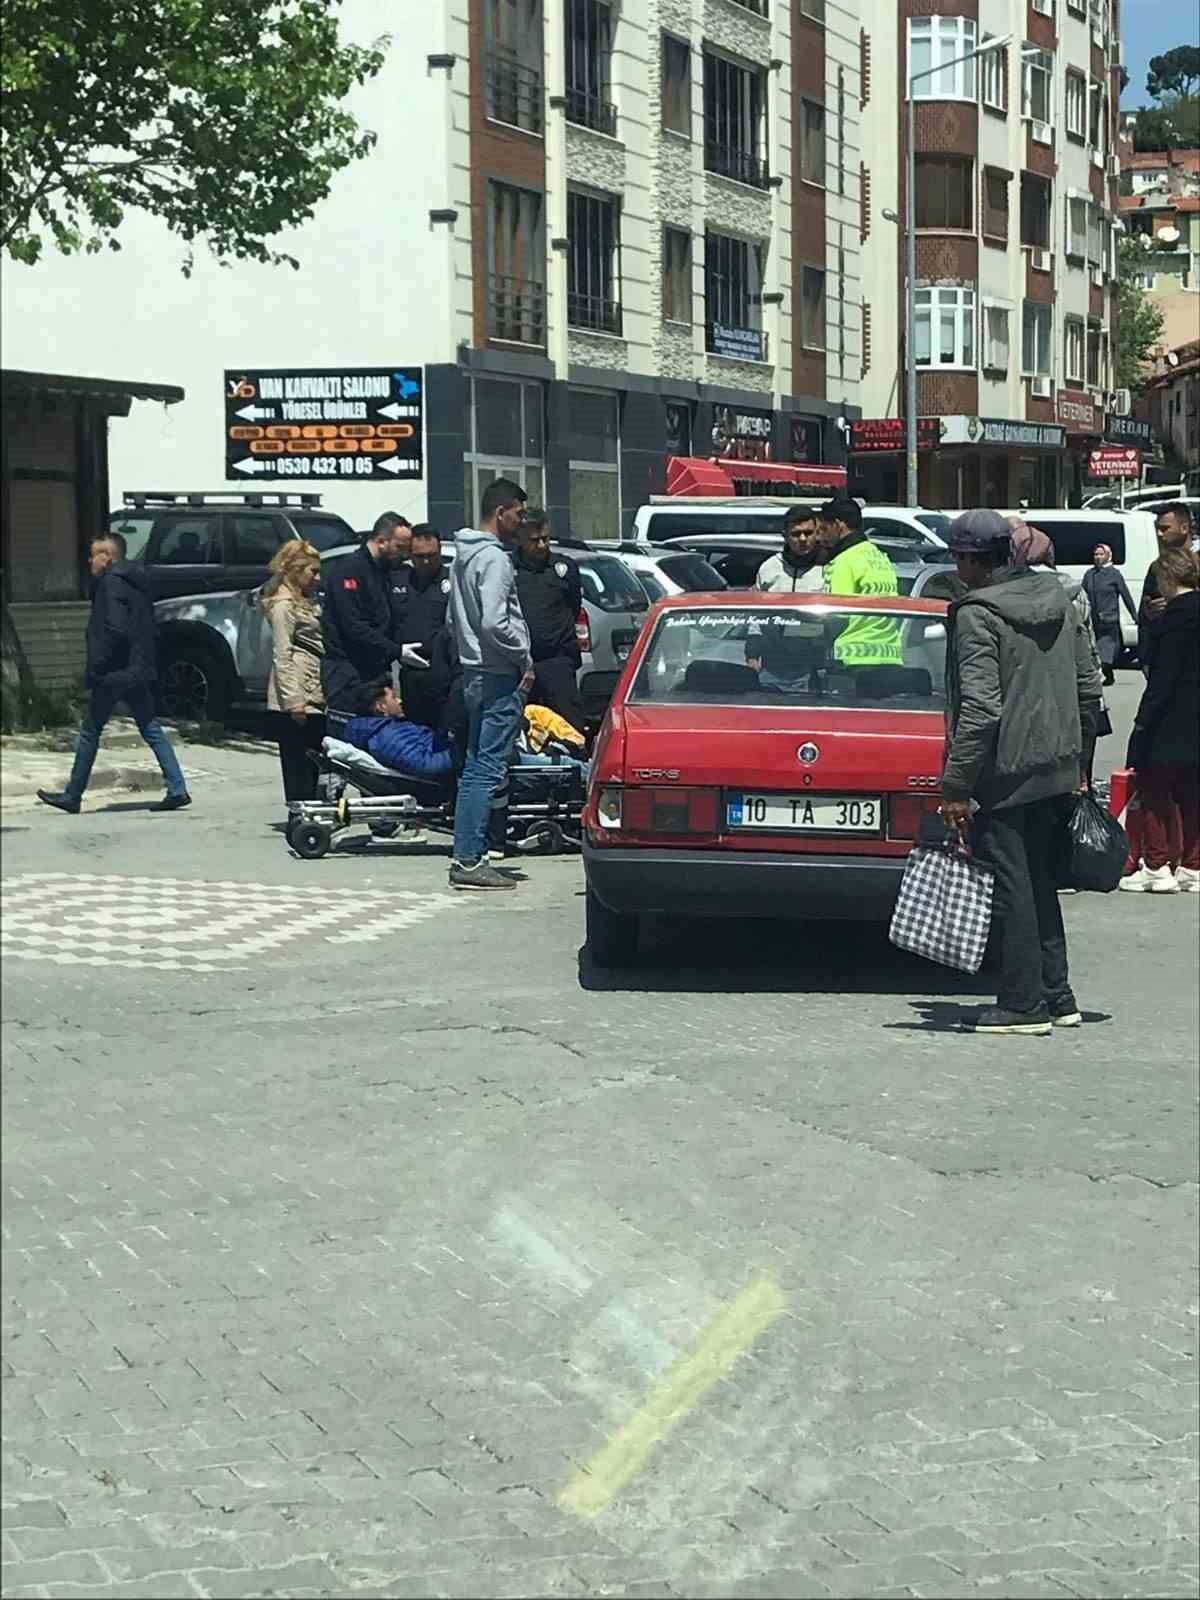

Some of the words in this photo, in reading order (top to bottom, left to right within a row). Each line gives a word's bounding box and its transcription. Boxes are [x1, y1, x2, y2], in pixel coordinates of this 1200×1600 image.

[258, 376, 283, 399] VAN
[284, 376, 341, 399] KAHVALTI
[343, 375, 391, 398] SALONU
[276, 457, 310, 475] 0530
[312, 457, 337, 475] 432
[338, 457, 355, 474] 10
[745, 797, 767, 822] 10
[789, 799, 814, 825] TA
[836, 801, 875, 826] 303
